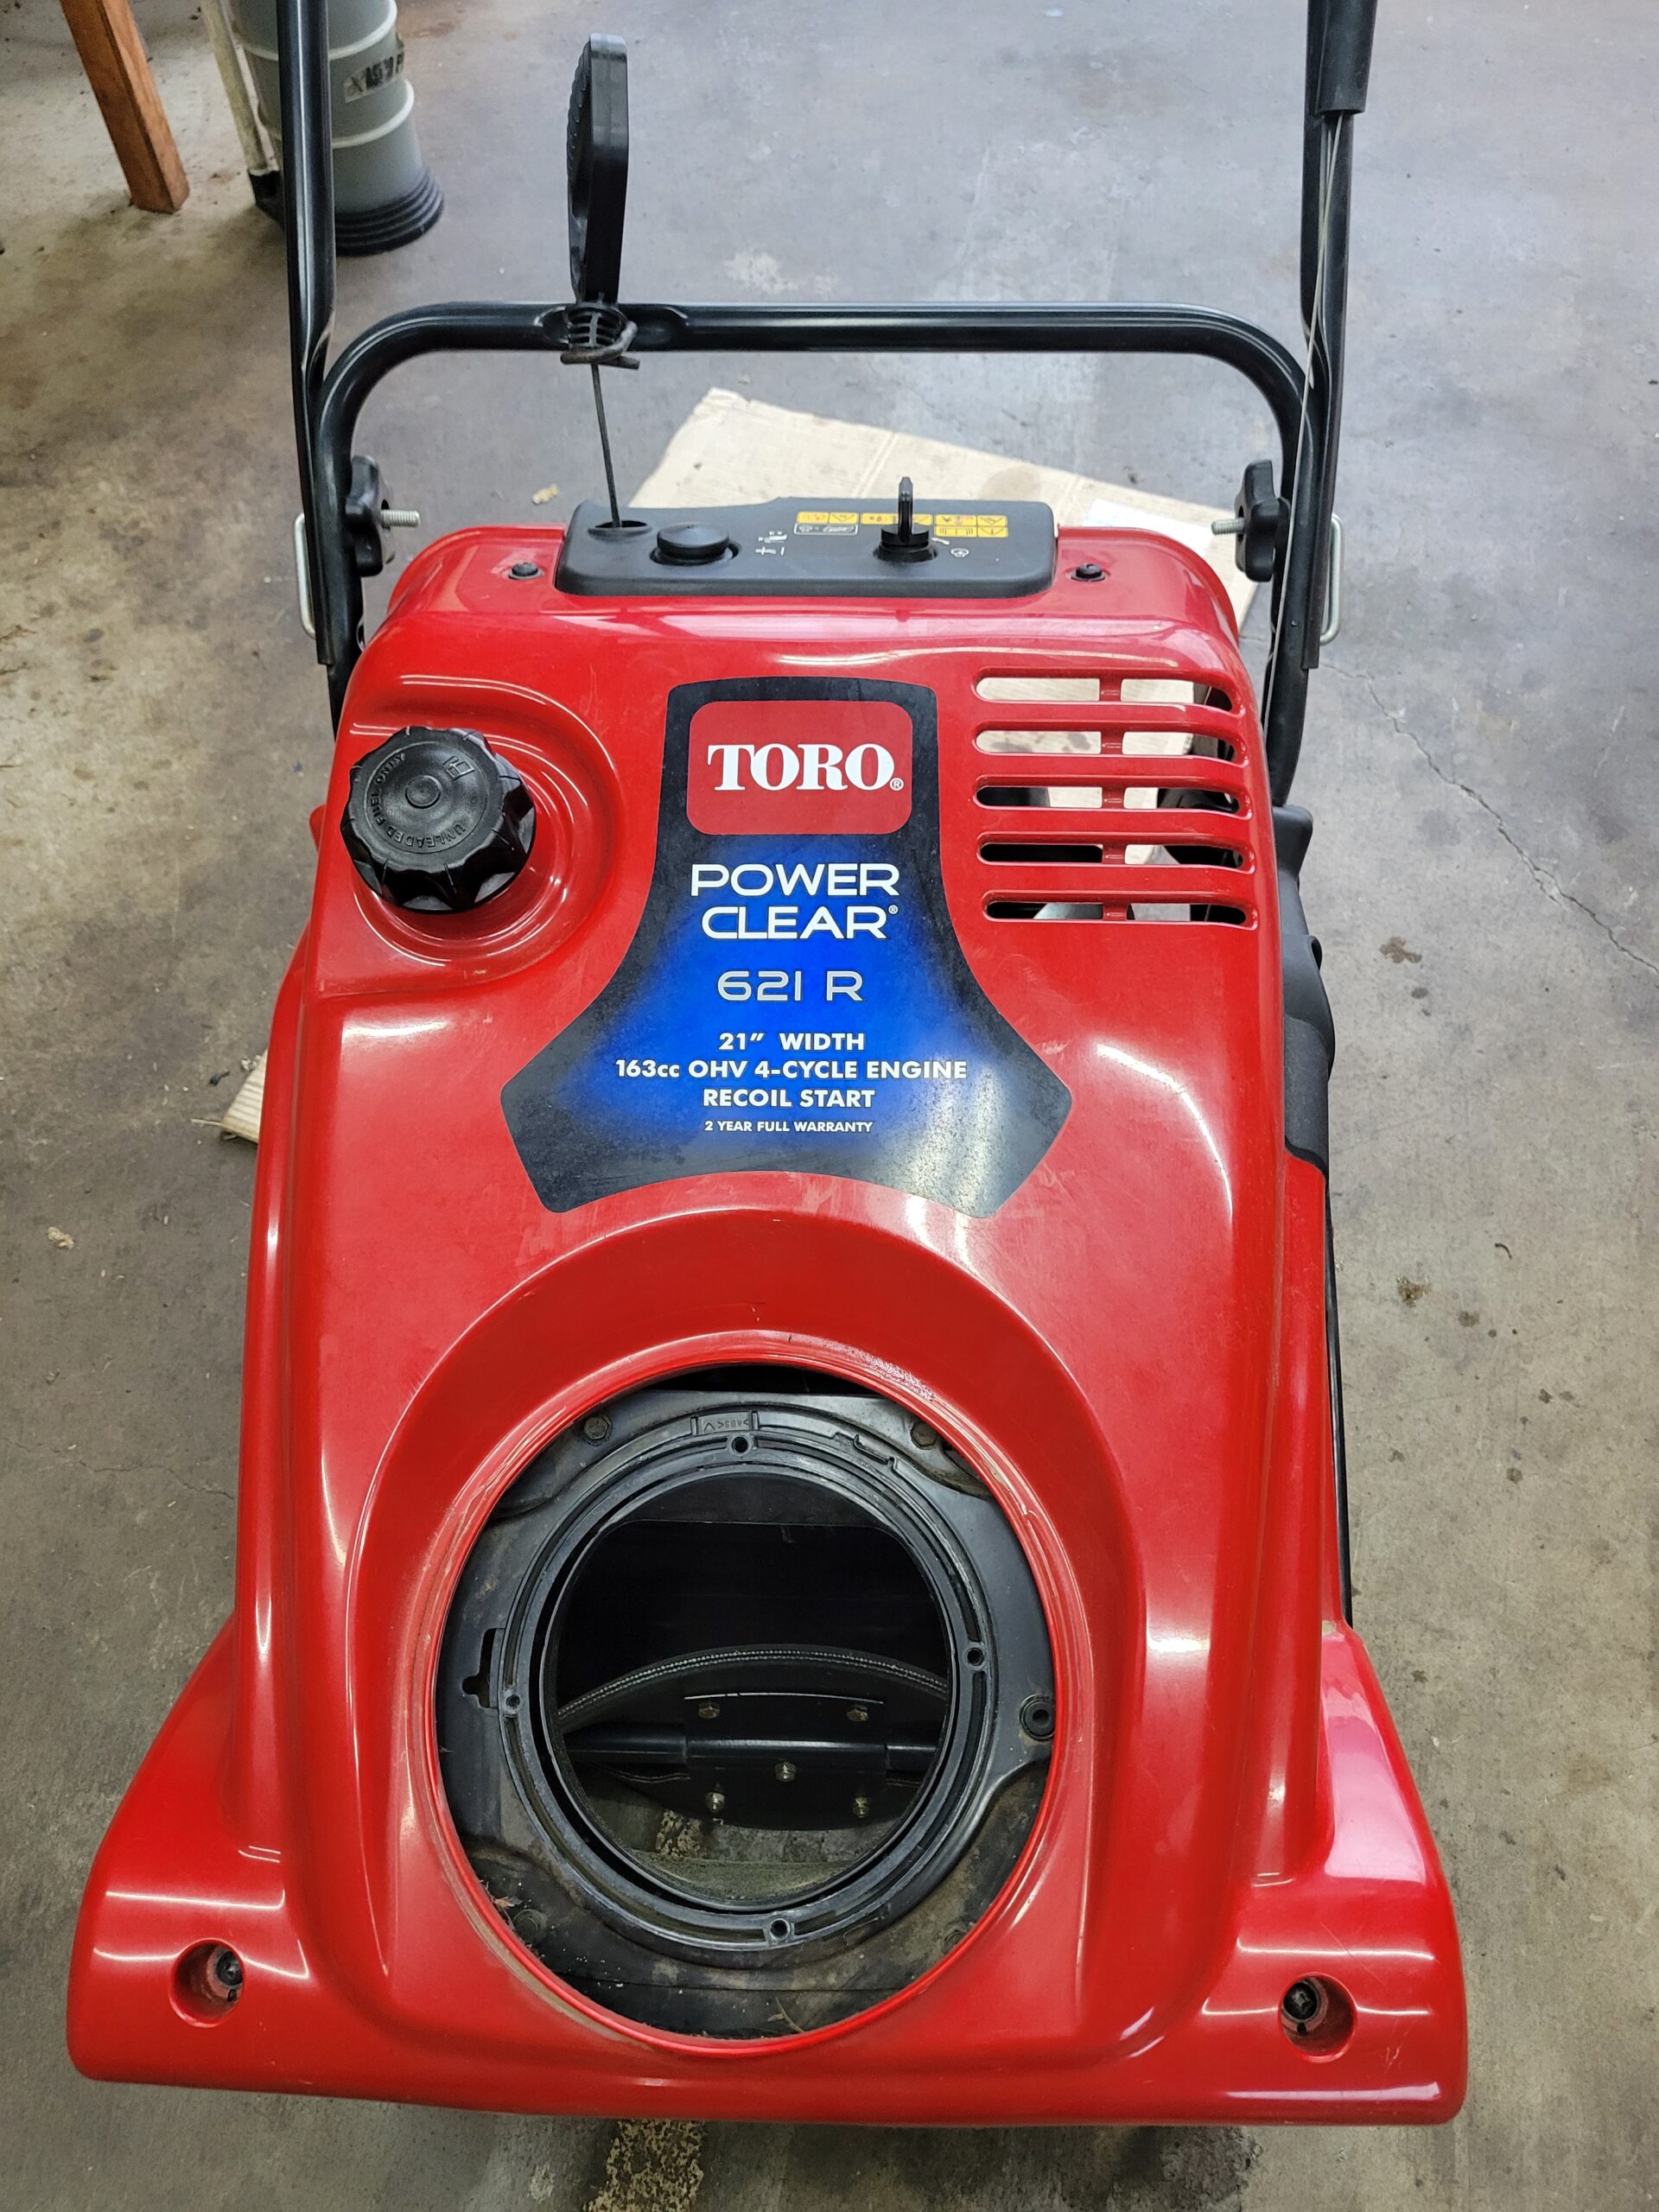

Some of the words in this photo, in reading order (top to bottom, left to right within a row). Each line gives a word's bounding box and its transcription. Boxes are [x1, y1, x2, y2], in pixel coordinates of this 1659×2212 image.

[376, 752, 406, 785] ONLY
[385, 823, 467, 849] UNLEADED
[690, 863, 900, 897] POWER
[717, 969, 803, 1002] 621
[826, 969, 864, 1002] R
[779, 1033, 865, 1051] WIDTH
[614, 1059, 680, 1078] 163cc
[687, 1060, 748, 1079] OHV
[753, 1060, 858, 1079] 4-CYCLE
[866, 1060, 968, 1079] ENGINE
[702, 1088, 792, 1109] RECOIL
[798, 1088, 876, 1109] START
[703, 1120, 714, 1132] 2
[716, 1120, 753, 1132] YEAR
[757, 1121, 791, 1133] FULL
[792, 1121, 874, 1134] WARRANTY
